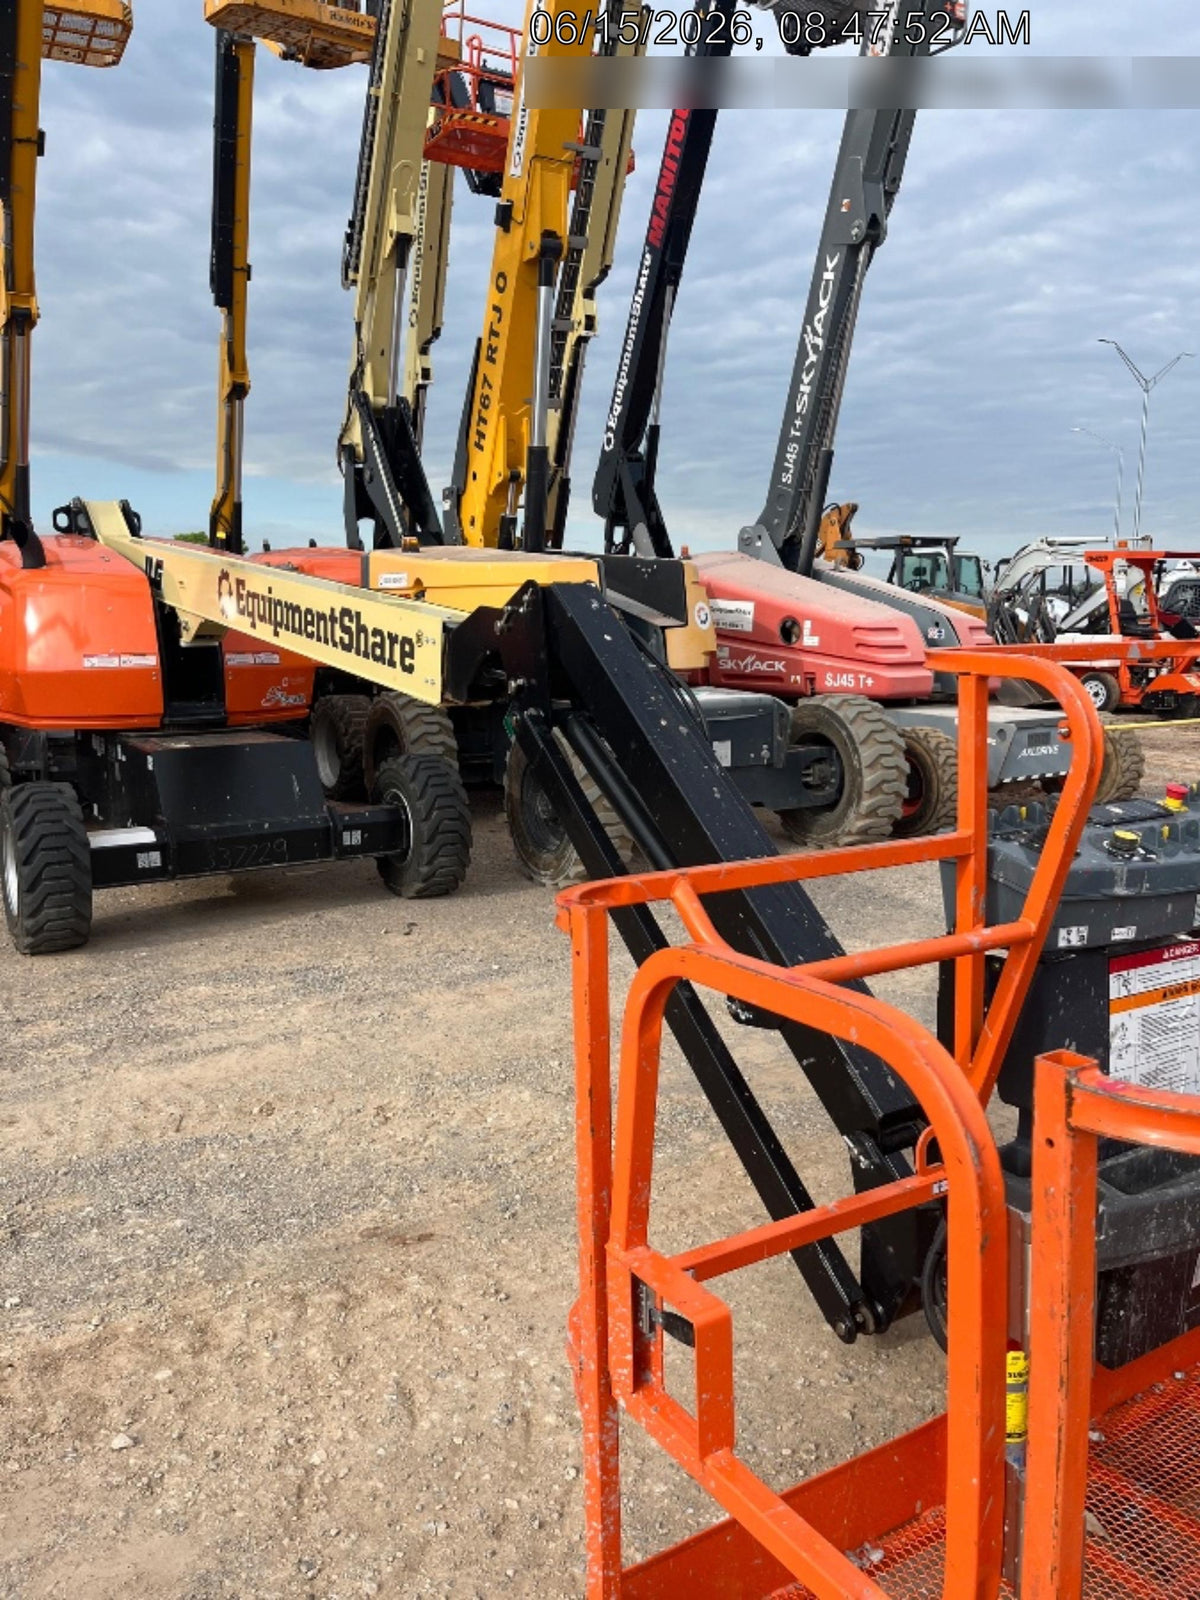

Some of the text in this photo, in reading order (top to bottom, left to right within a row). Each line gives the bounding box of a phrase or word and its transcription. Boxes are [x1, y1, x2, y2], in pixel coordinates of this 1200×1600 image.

[796, 251, 840, 416] SKYJACK
[474, 372, 493, 452] HT67
[485, 304, 503, 365] RTJ
[781, 442, 799, 485] SJ45
[718, 653, 787, 673] SKYJACK
[824, 671, 875, 689] SJ45 T+
